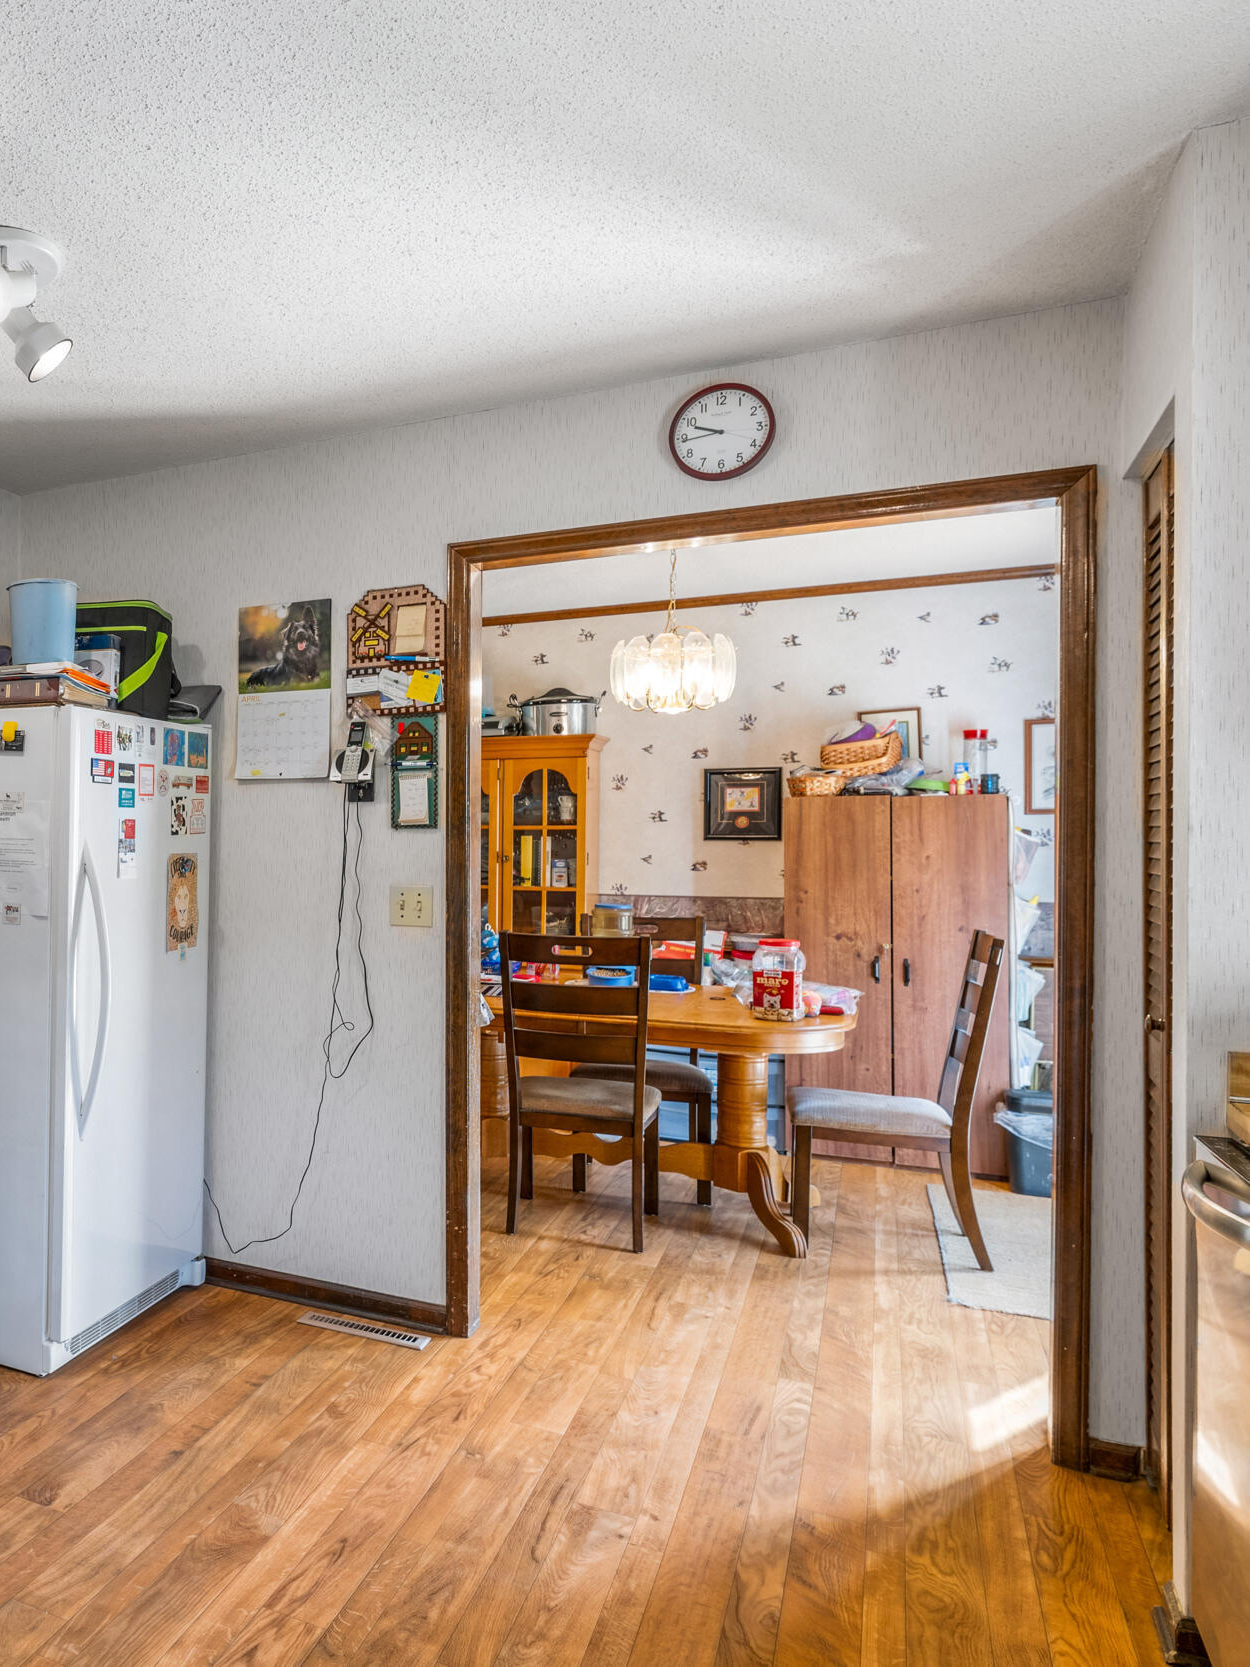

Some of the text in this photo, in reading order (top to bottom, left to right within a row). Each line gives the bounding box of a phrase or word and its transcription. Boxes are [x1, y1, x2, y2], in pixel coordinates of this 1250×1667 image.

[716, 395, 727, 406] 12
[701, 403, 708, 413] 11
[750, 406, 758, 416] 2
[687, 417, 697, 427] 10
[756, 422, 764, 431] 3
[681, 433, 688, 443] 9
[750, 439, 757, 448] 4
[686, 449, 694, 458] 8
[736, 453, 744, 463] 5
[700, 458, 707, 467] 7
[718, 459, 725, 469] 6
[241, 695, 261, 703] APRIL
[169, 923, 194, 942] COURAGE
